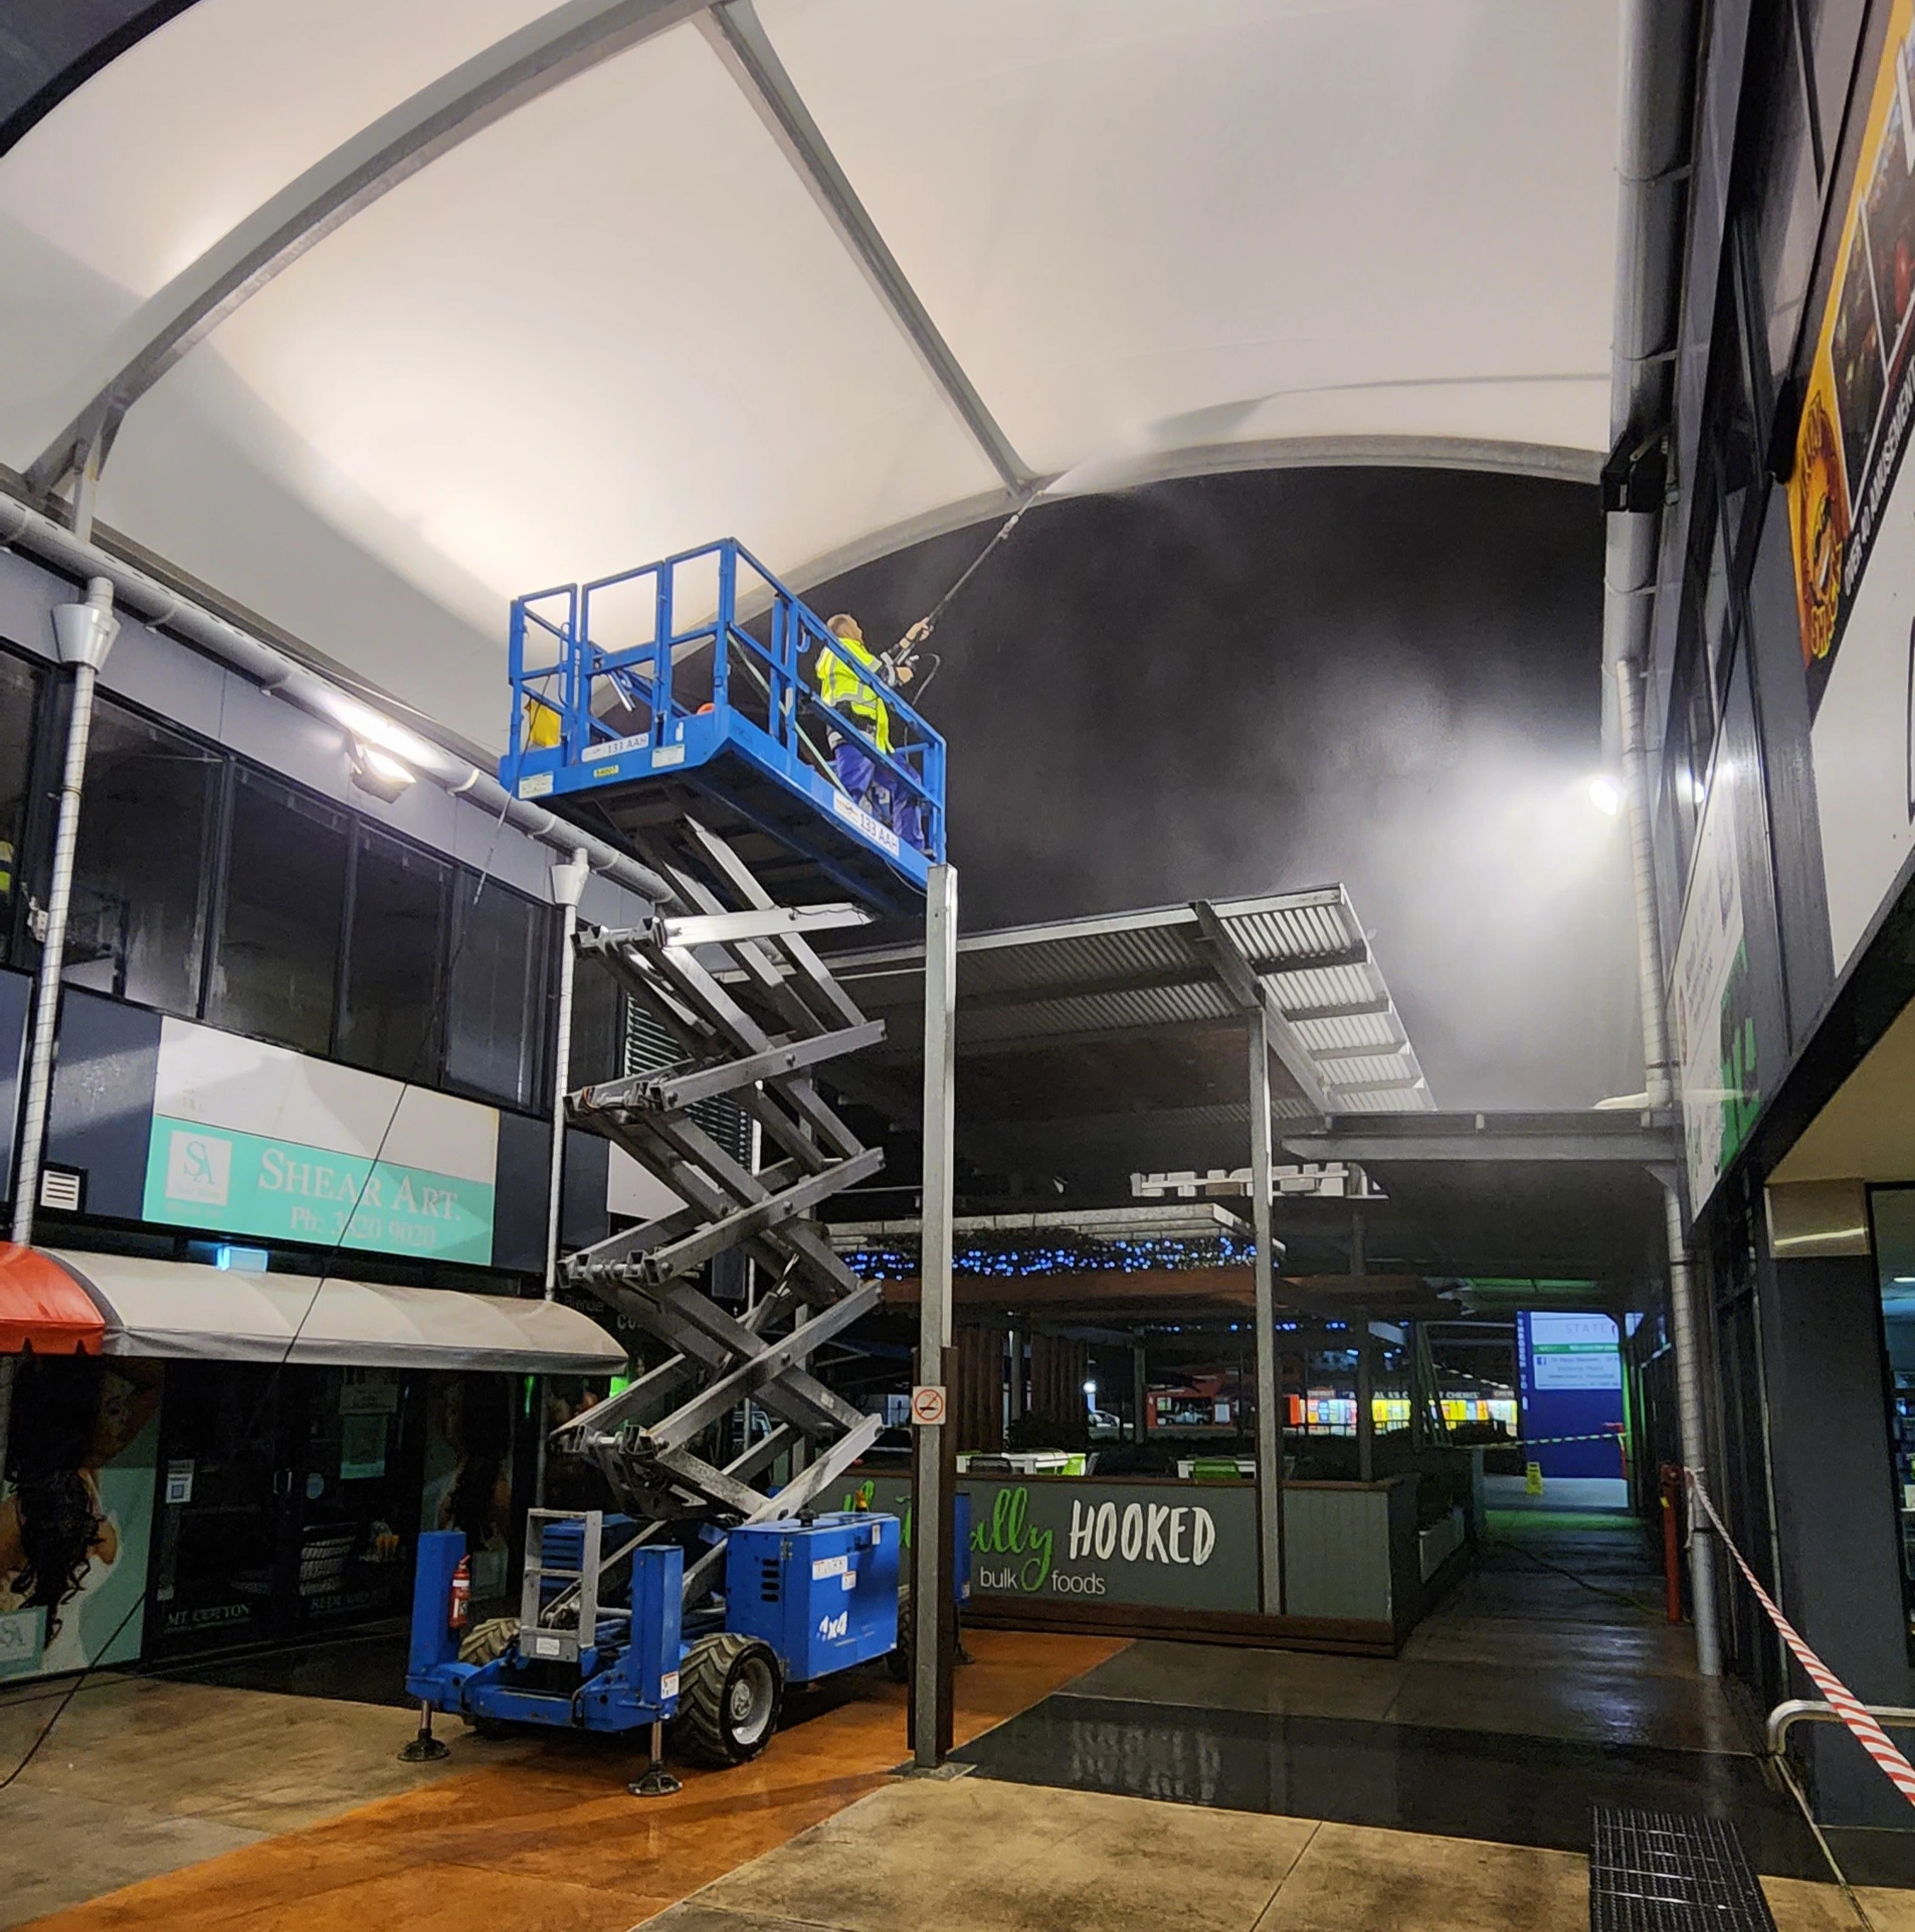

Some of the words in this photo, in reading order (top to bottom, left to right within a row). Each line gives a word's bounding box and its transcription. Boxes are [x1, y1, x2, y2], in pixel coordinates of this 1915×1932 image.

[607, 742, 623, 753] 133
[860, 813, 877, 837] 133
[183, 1140, 215, 1185] SA
[259, 1147, 382, 1207] SHEAR
[290, 1205, 321, 1232] Ph:
[388, 1216, 436, 1247] 9020
[1069, 1499, 1216, 1565] HOOKED
[980, 1565, 1019, 1589] bulk
[1051, 1571, 1106, 1595] foods
